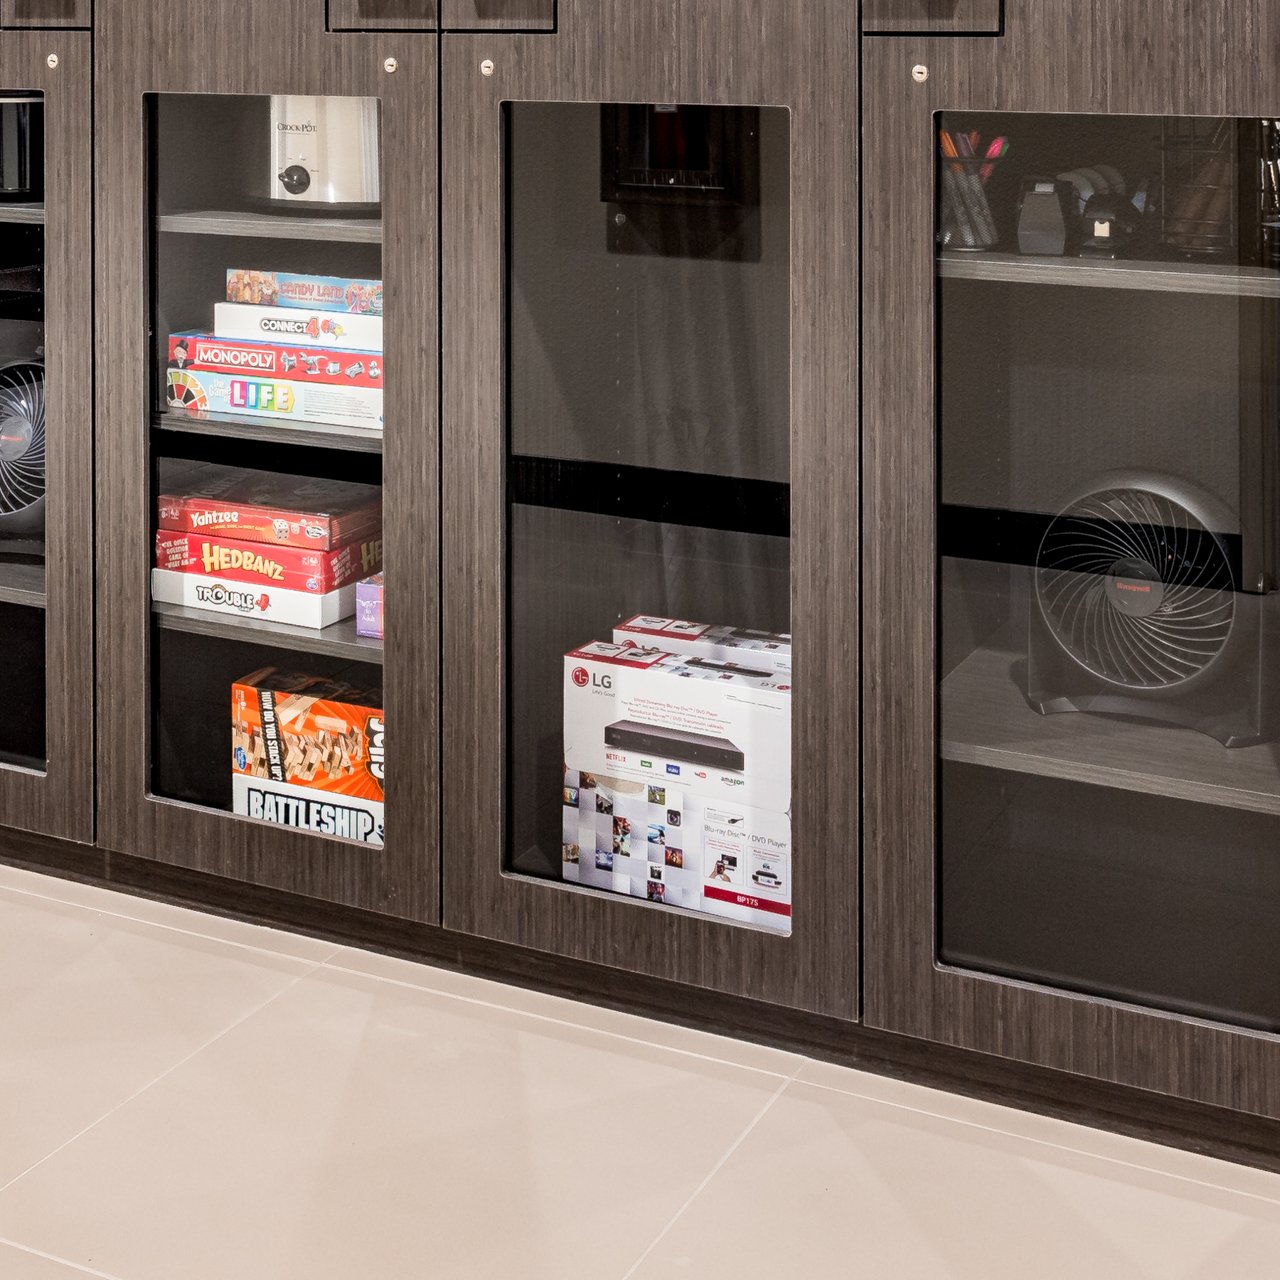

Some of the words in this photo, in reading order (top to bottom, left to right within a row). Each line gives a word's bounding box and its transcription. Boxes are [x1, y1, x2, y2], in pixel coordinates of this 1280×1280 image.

[278, 282, 314, 296] CANDY
[317, 285, 344, 299] LAND
[261, 319, 307, 333] CONNECT
[306, 318, 319, 337] 4
[200, 348, 273, 368] MONOPOLY
[233, 382, 289, 410] LIFE
[190, 511, 239, 528] Yahtzee
[201, 542, 284, 580] HEDBANZ
[196, 586, 254, 608] TROUBLE
[593, 673, 612, 689] LG
[261, 691, 274, 709] HOW
[263, 710, 275, 722] DO
[265, 723, 277, 738] YOU
[267, 740, 280, 765] STACK
[606, 753, 626, 762] NETFLIX
[271, 765, 283, 781] UP?
[721, 776, 744, 786] amazon
[249, 789, 372, 841] BATTLESHIP
[704, 824, 726, 836] Blu-ray
[752, 834, 766, 844] DVD
[767, 838, 787, 849] Player
